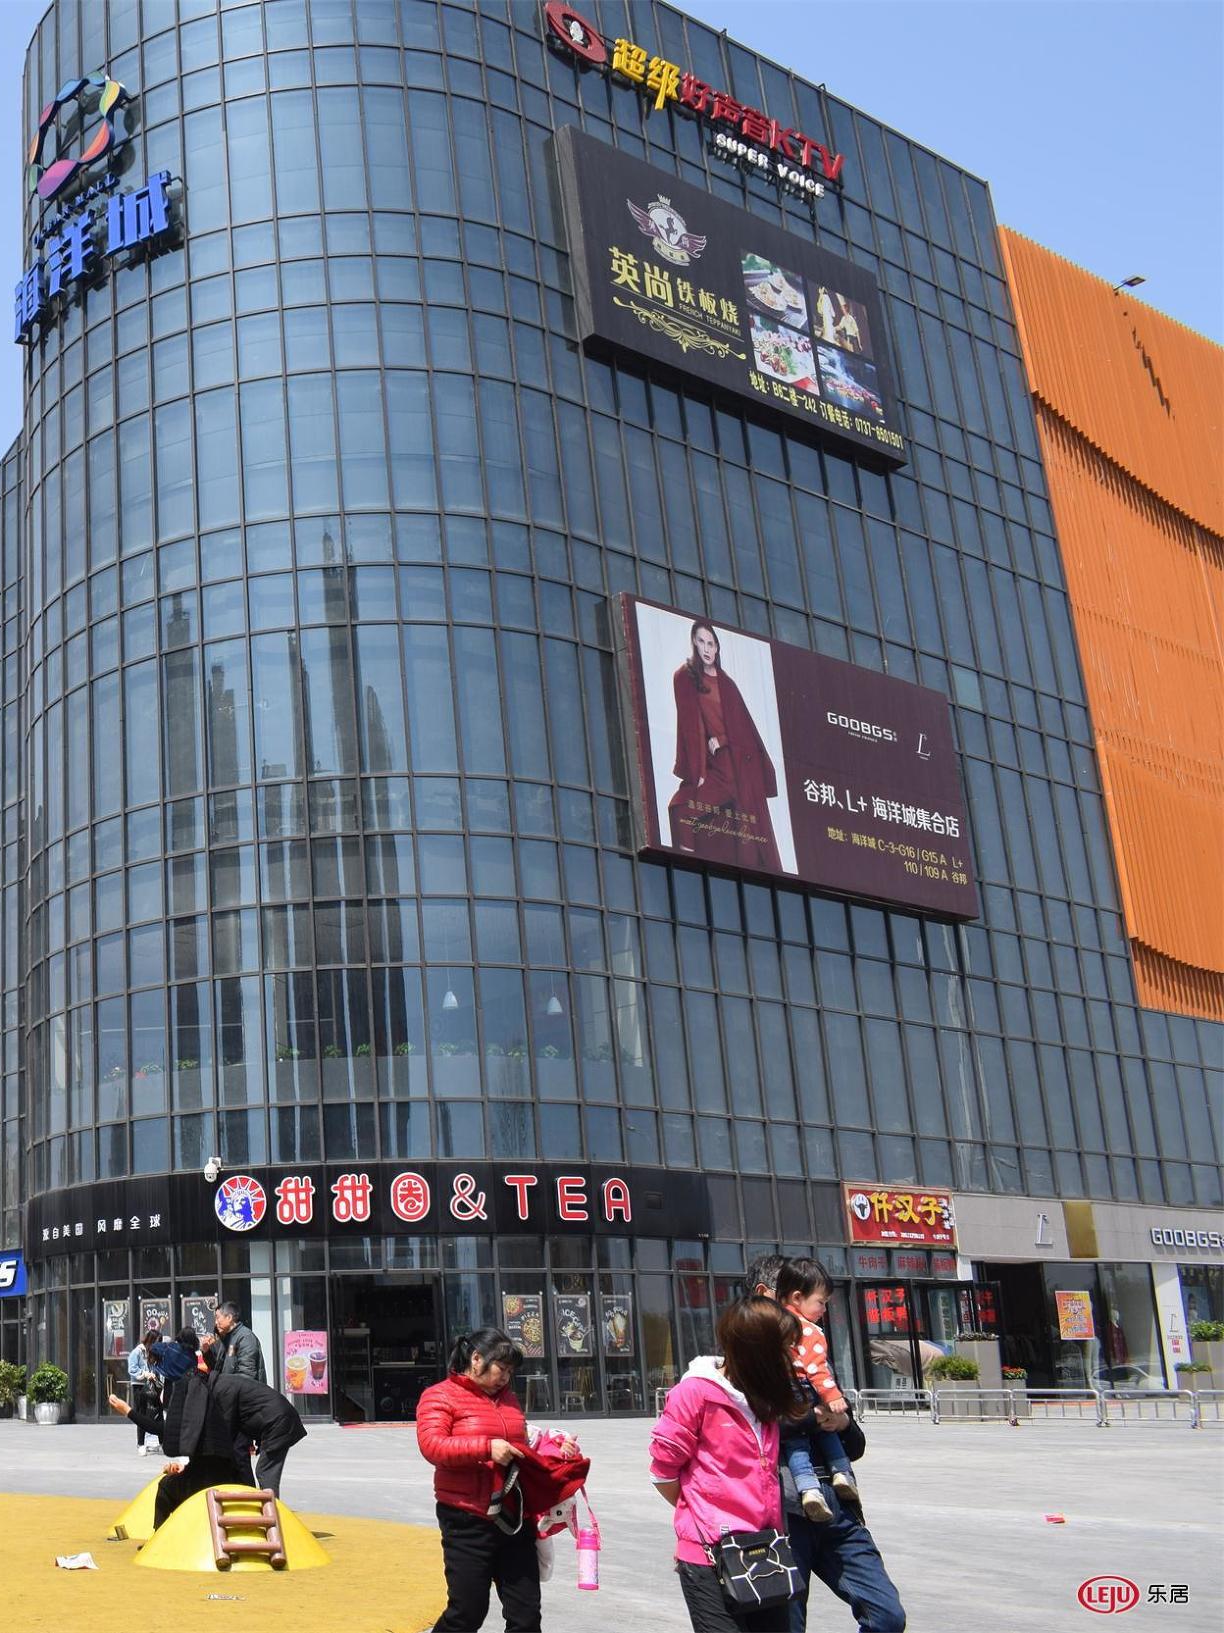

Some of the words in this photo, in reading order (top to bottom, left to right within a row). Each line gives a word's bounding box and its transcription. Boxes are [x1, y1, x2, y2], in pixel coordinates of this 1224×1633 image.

[716, 133, 769, 170] SUPER
[777, 163, 825, 198] VOICE
[871, 795, 960, 838] 海洋城集合店
[449, 1172, 488, 1222] &
[504, 1174, 633, 1223] TEA
